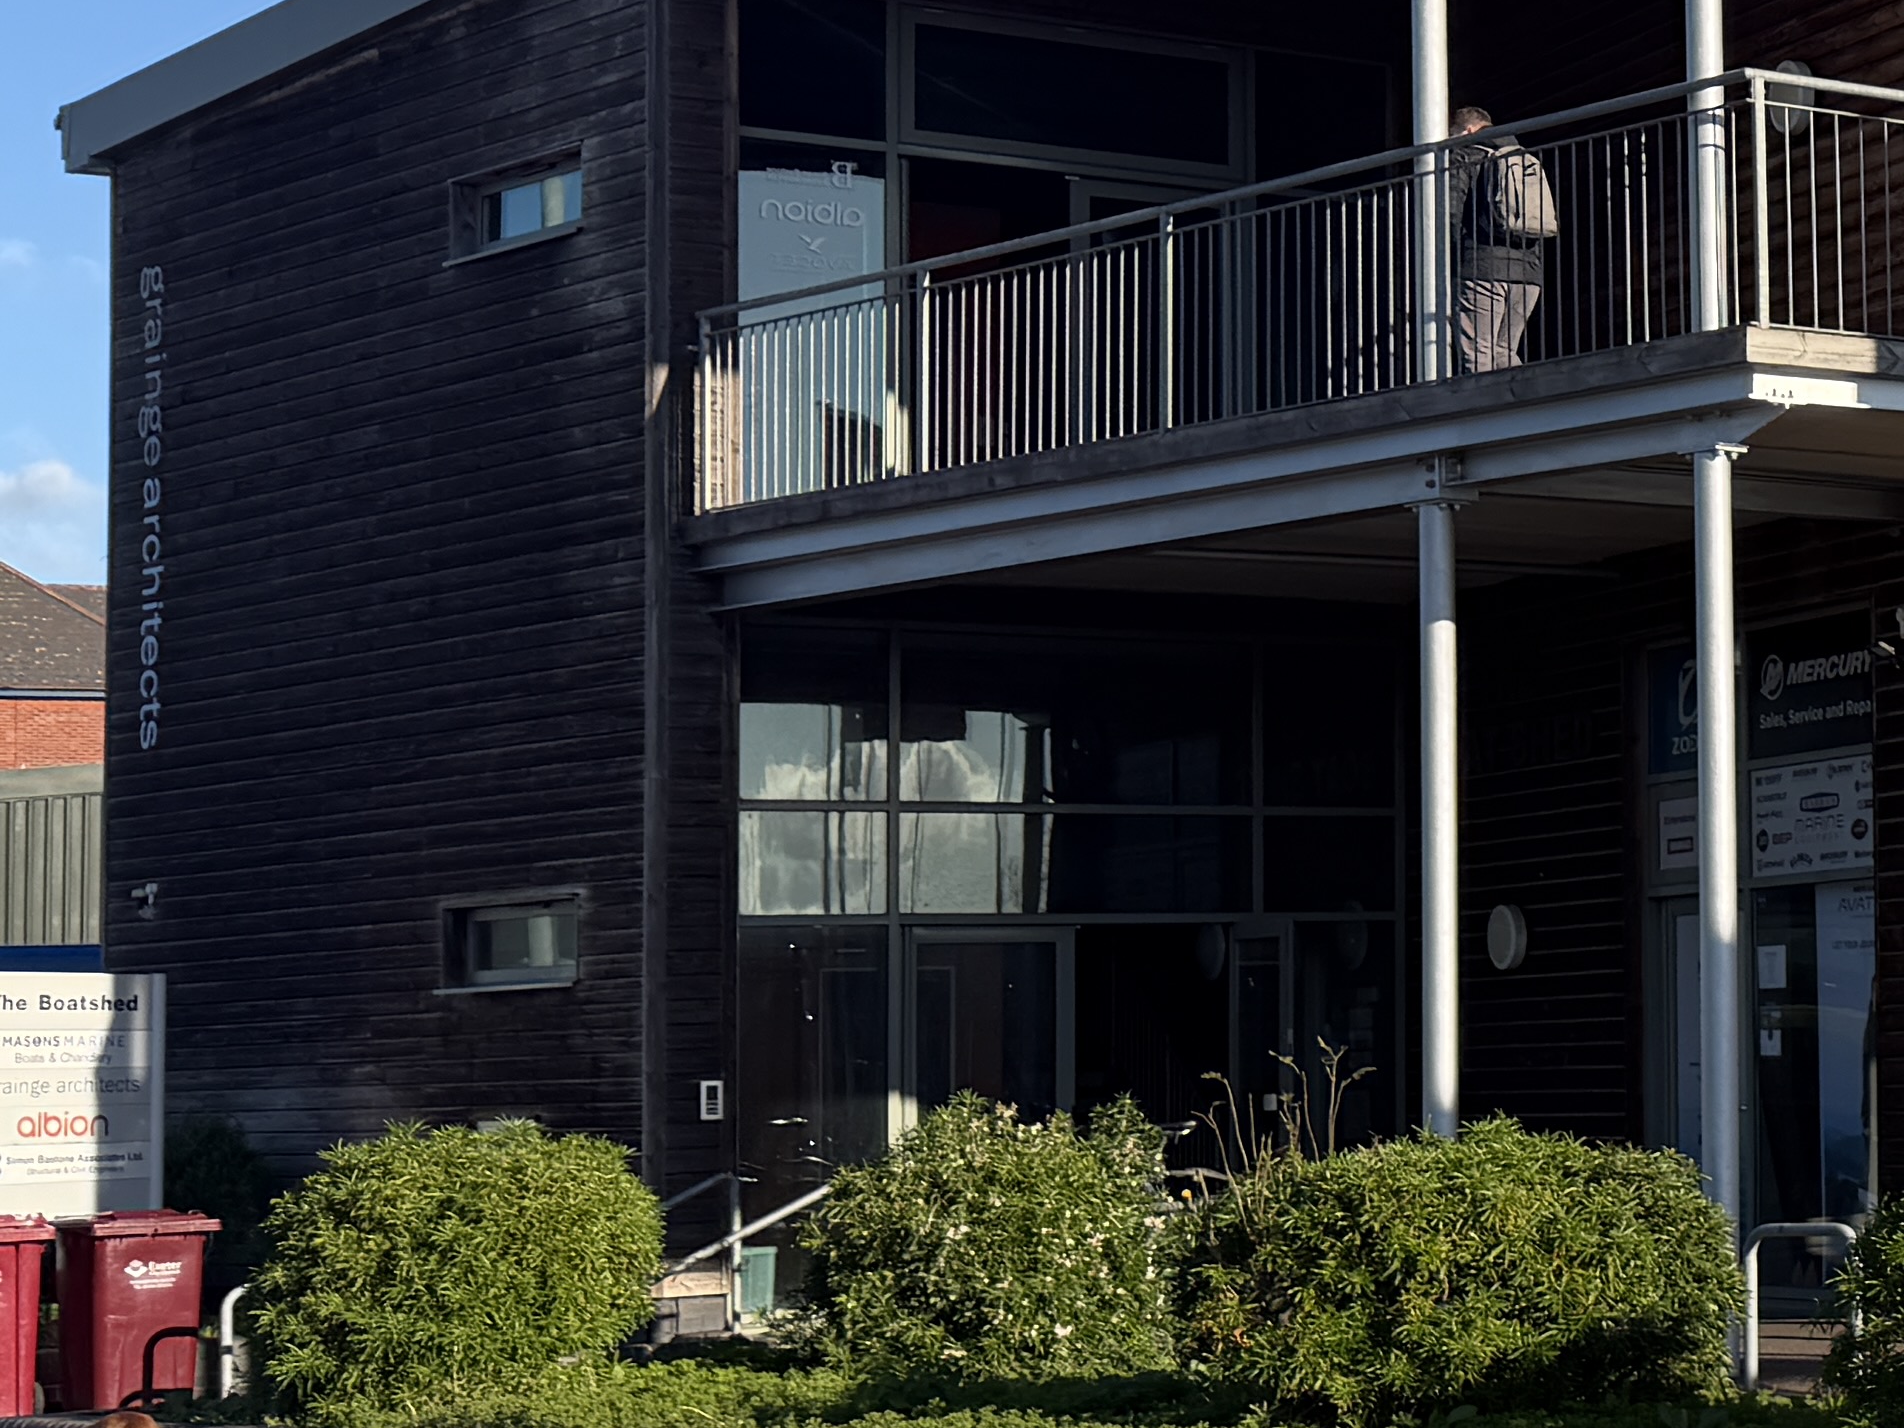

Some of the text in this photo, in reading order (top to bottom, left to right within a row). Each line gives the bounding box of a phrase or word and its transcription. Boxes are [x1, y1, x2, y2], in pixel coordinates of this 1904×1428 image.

[139, 266, 168, 750] grainge architects
[1786, 650, 1872, 685] MERCURY
[1788, 705, 1823, 725] Service
[1825, 701, 1844, 719] and
[0, 994, 138, 1012] he Boatshed
[2, 1035, 126, 1048] MASONS MARINE
[56, 1077, 142, 1094] architects
[17, 1110, 109, 1138] albion
